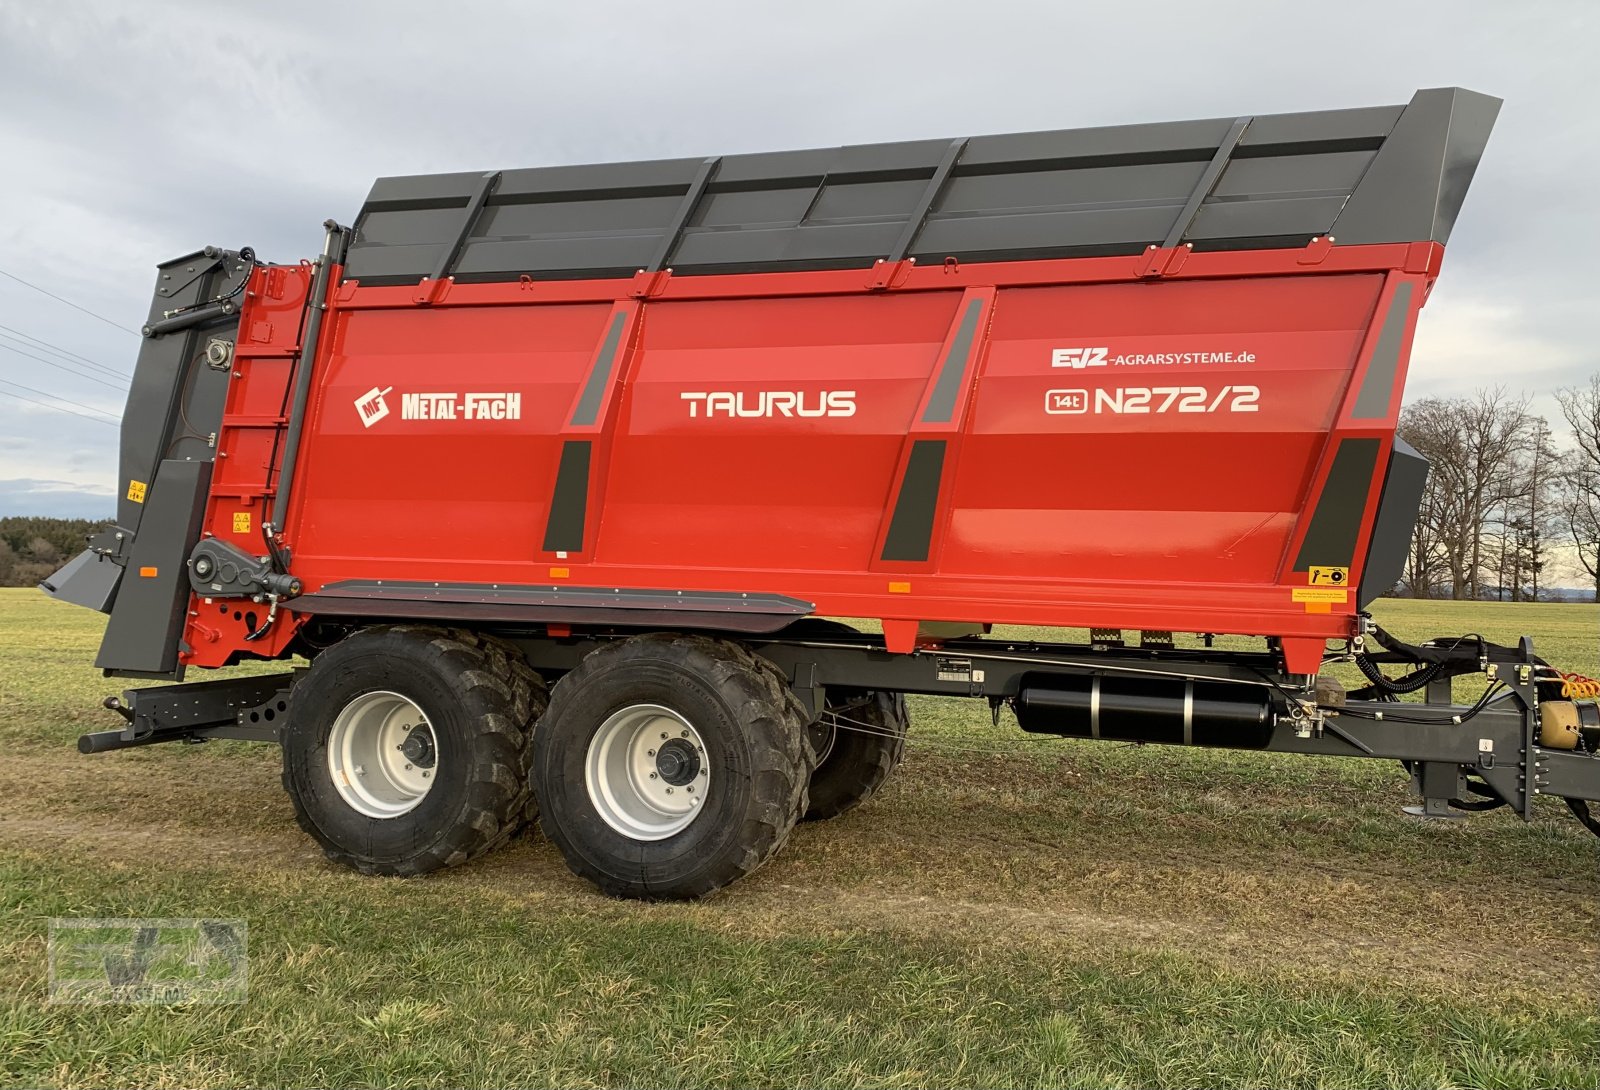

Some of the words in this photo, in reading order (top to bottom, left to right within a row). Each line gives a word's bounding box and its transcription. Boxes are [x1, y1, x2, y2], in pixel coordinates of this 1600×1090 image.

[362, 394, 381, 419] MF
[401, 392, 521, 420] METAL-FACH
[680, 390, 857, 418] TAURUS
[1053, 395, 1080, 408] 14t
[1094, 385, 1261, 414] N272/2
